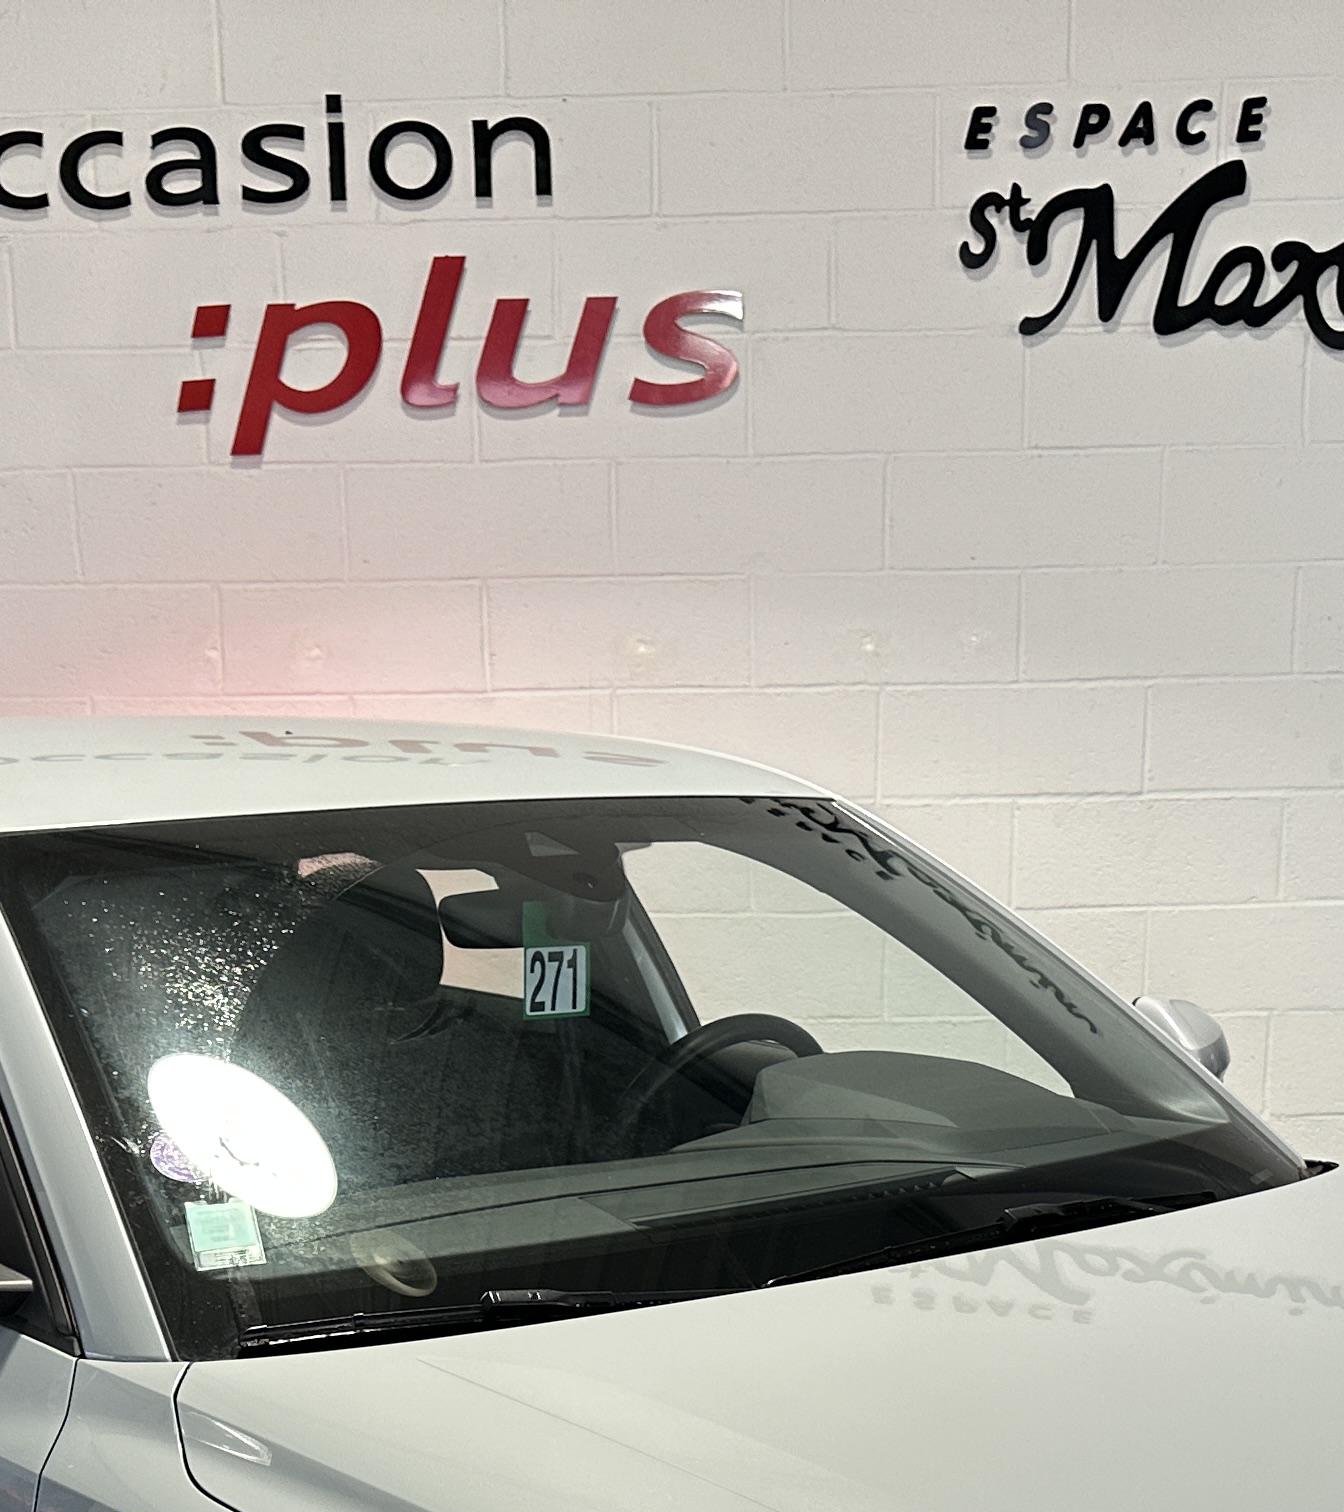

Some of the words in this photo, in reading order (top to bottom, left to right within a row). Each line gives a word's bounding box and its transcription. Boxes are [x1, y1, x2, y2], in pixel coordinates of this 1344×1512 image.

[963, 96, 1268, 151] ESPACE
[175, 255, 746, 457] :plus
[529, 948, 578, 1013] 271
